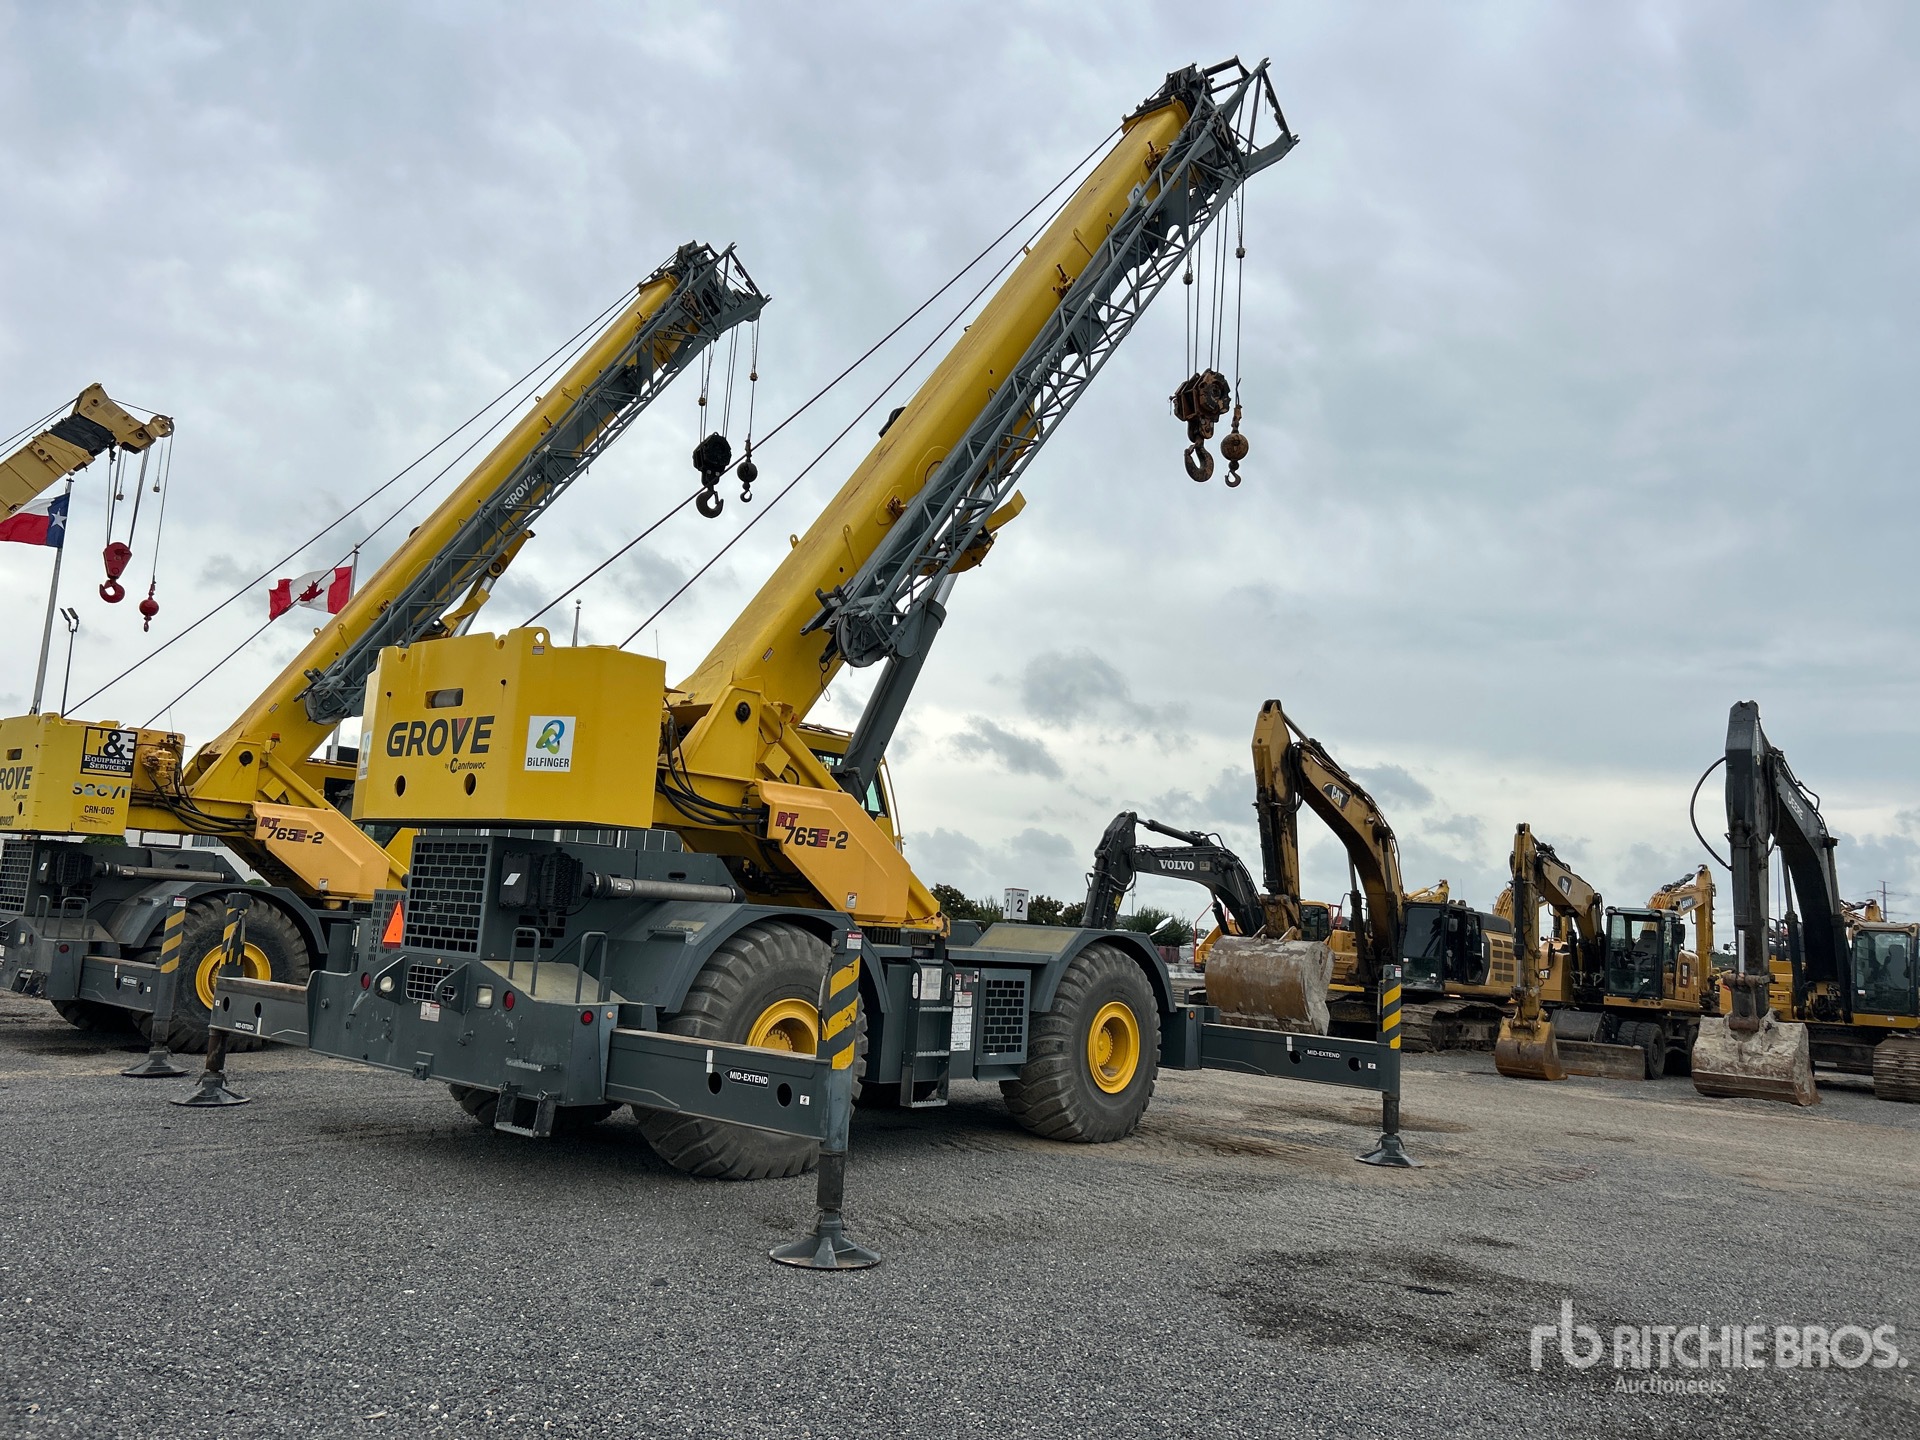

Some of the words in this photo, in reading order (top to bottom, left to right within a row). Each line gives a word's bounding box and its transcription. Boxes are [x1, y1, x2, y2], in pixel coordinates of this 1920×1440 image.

[387, 716, 495, 757] GROVE
[86, 729, 136, 759] H&E
[84, 754, 133, 766] EQUIPMENT
[89, 761, 126, 772] SERVICES
[527, 757, 570, 768] BiLFINGER
[1331, 785, 1344, 807] CAT
[84, 805, 115, 815] CRN-005
[260, 817, 280, 828] RT
[775, 811, 799, 828] RT
[267, 827, 325, 845] 765E-2
[784, 826, 849, 850] 765E-2
[1158, 859, 1195, 871] VOLVO
[1005, 898, 1010, 912] 2
[1016, 898, 1024, 913] 2
[1306, 1049, 1340, 1059] MID-EXTEND
[729, 1070, 768, 1085] MID-EXTEND
